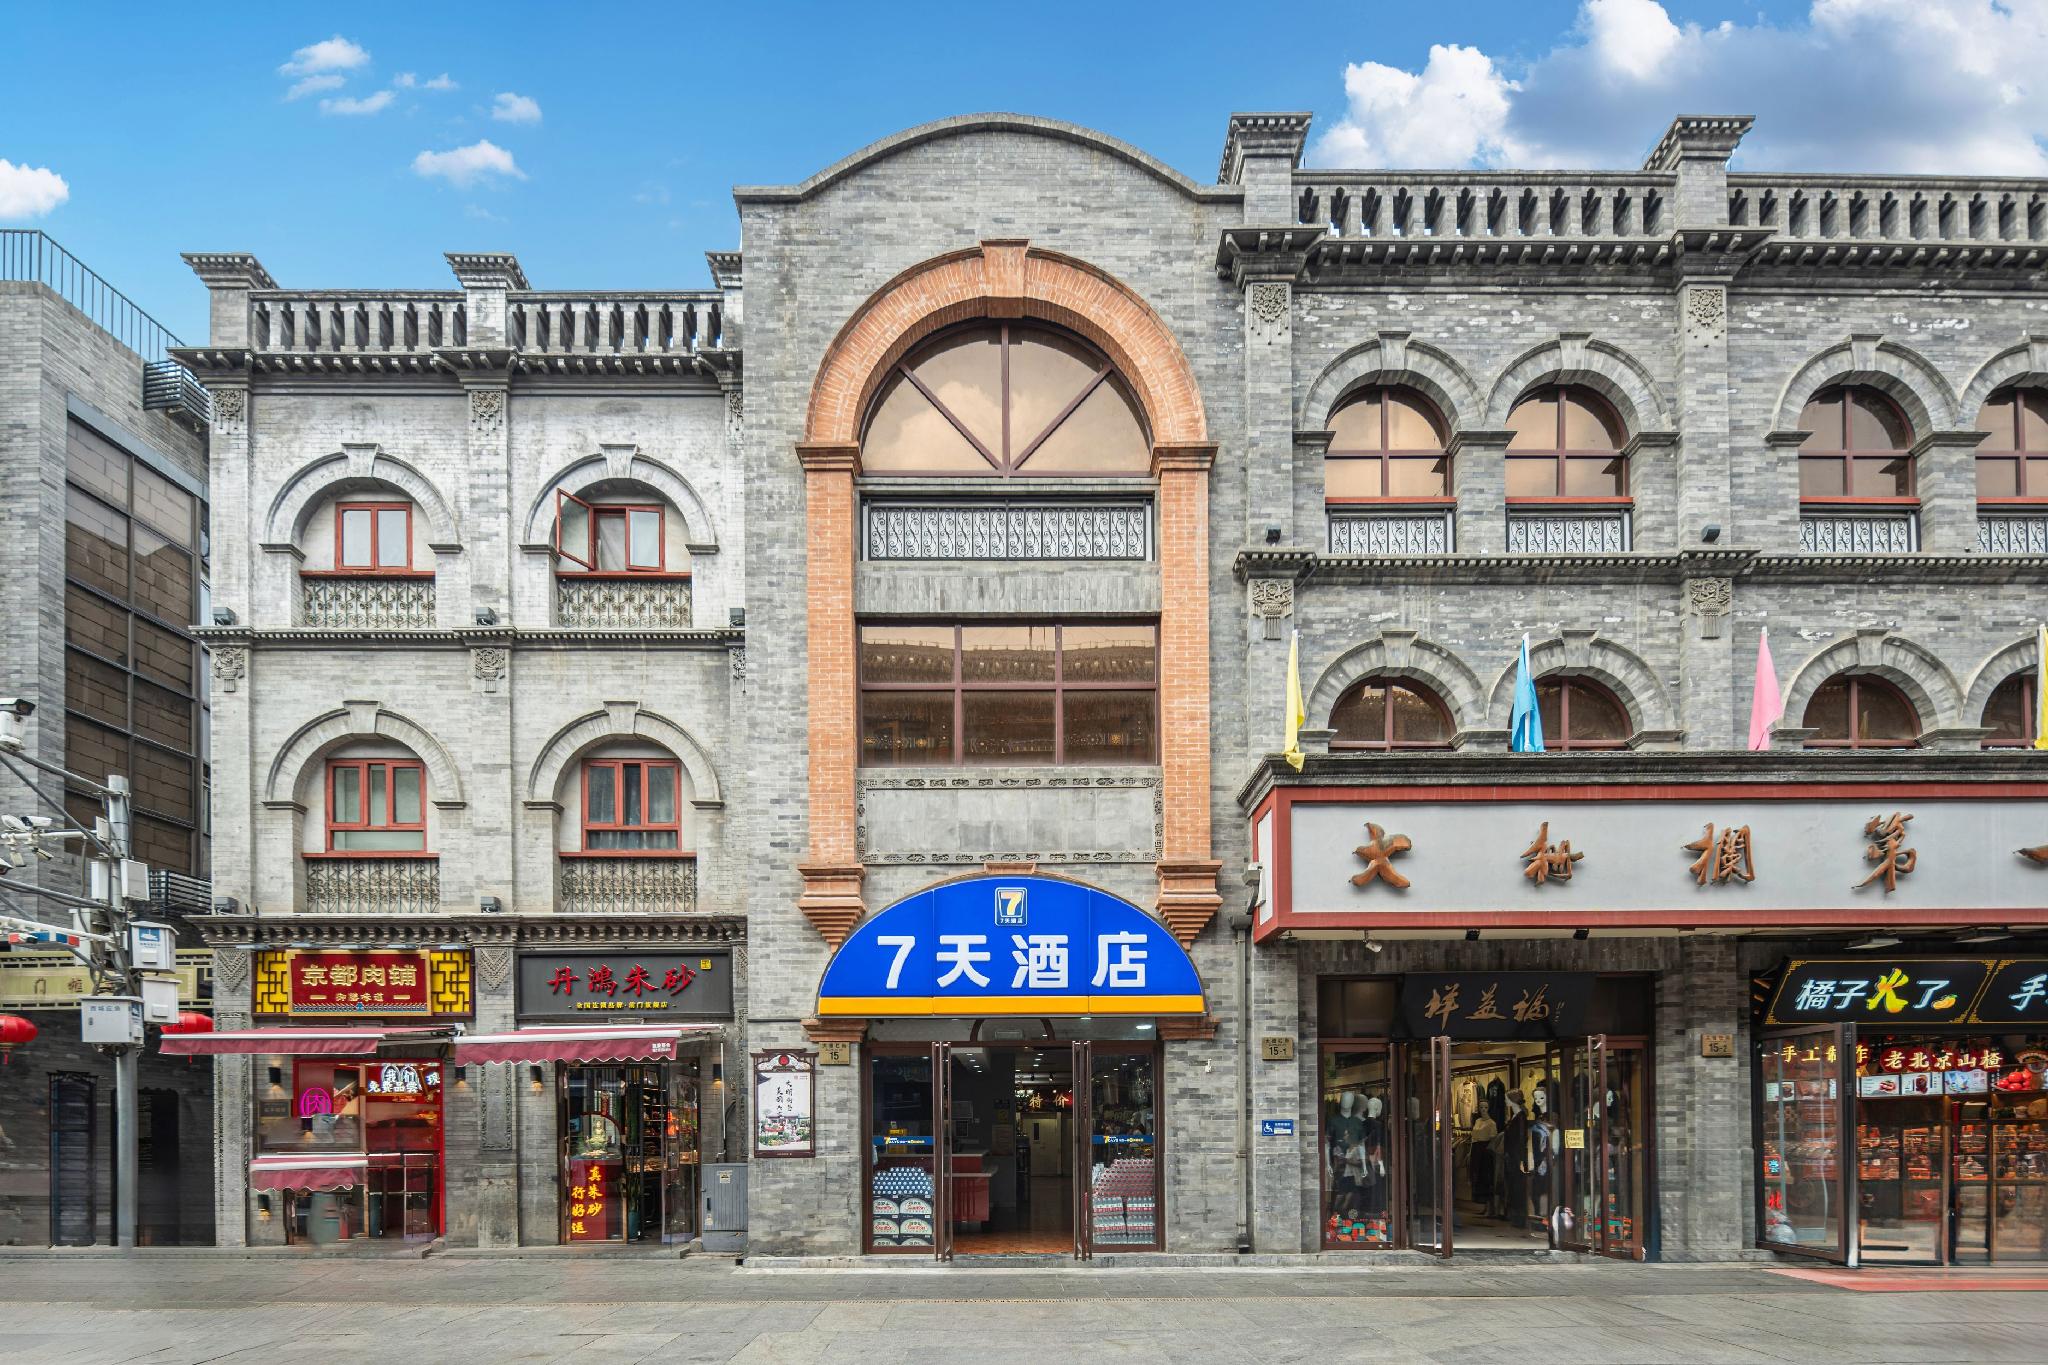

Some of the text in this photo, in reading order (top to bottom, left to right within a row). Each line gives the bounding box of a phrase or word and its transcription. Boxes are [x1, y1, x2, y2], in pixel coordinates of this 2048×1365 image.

[1000, 891, 1023, 916] 7
[877, 930, 1148, 989] 7天酒店
[301, 963, 418, 988] 京都肉铺
[2008, 973, 2048, 1011] 手
[829, 1051, 840, 1061] 15
[1269, 1046, 1287, 1056] 15-1
[1883, 1049, 2004, 1070] 老北京山楂
[1029, 1093, 1070, 1108] 特价
[587, 1165, 603, 1217] 真朱砂
[571, 1185, 589, 1235] 行好运
